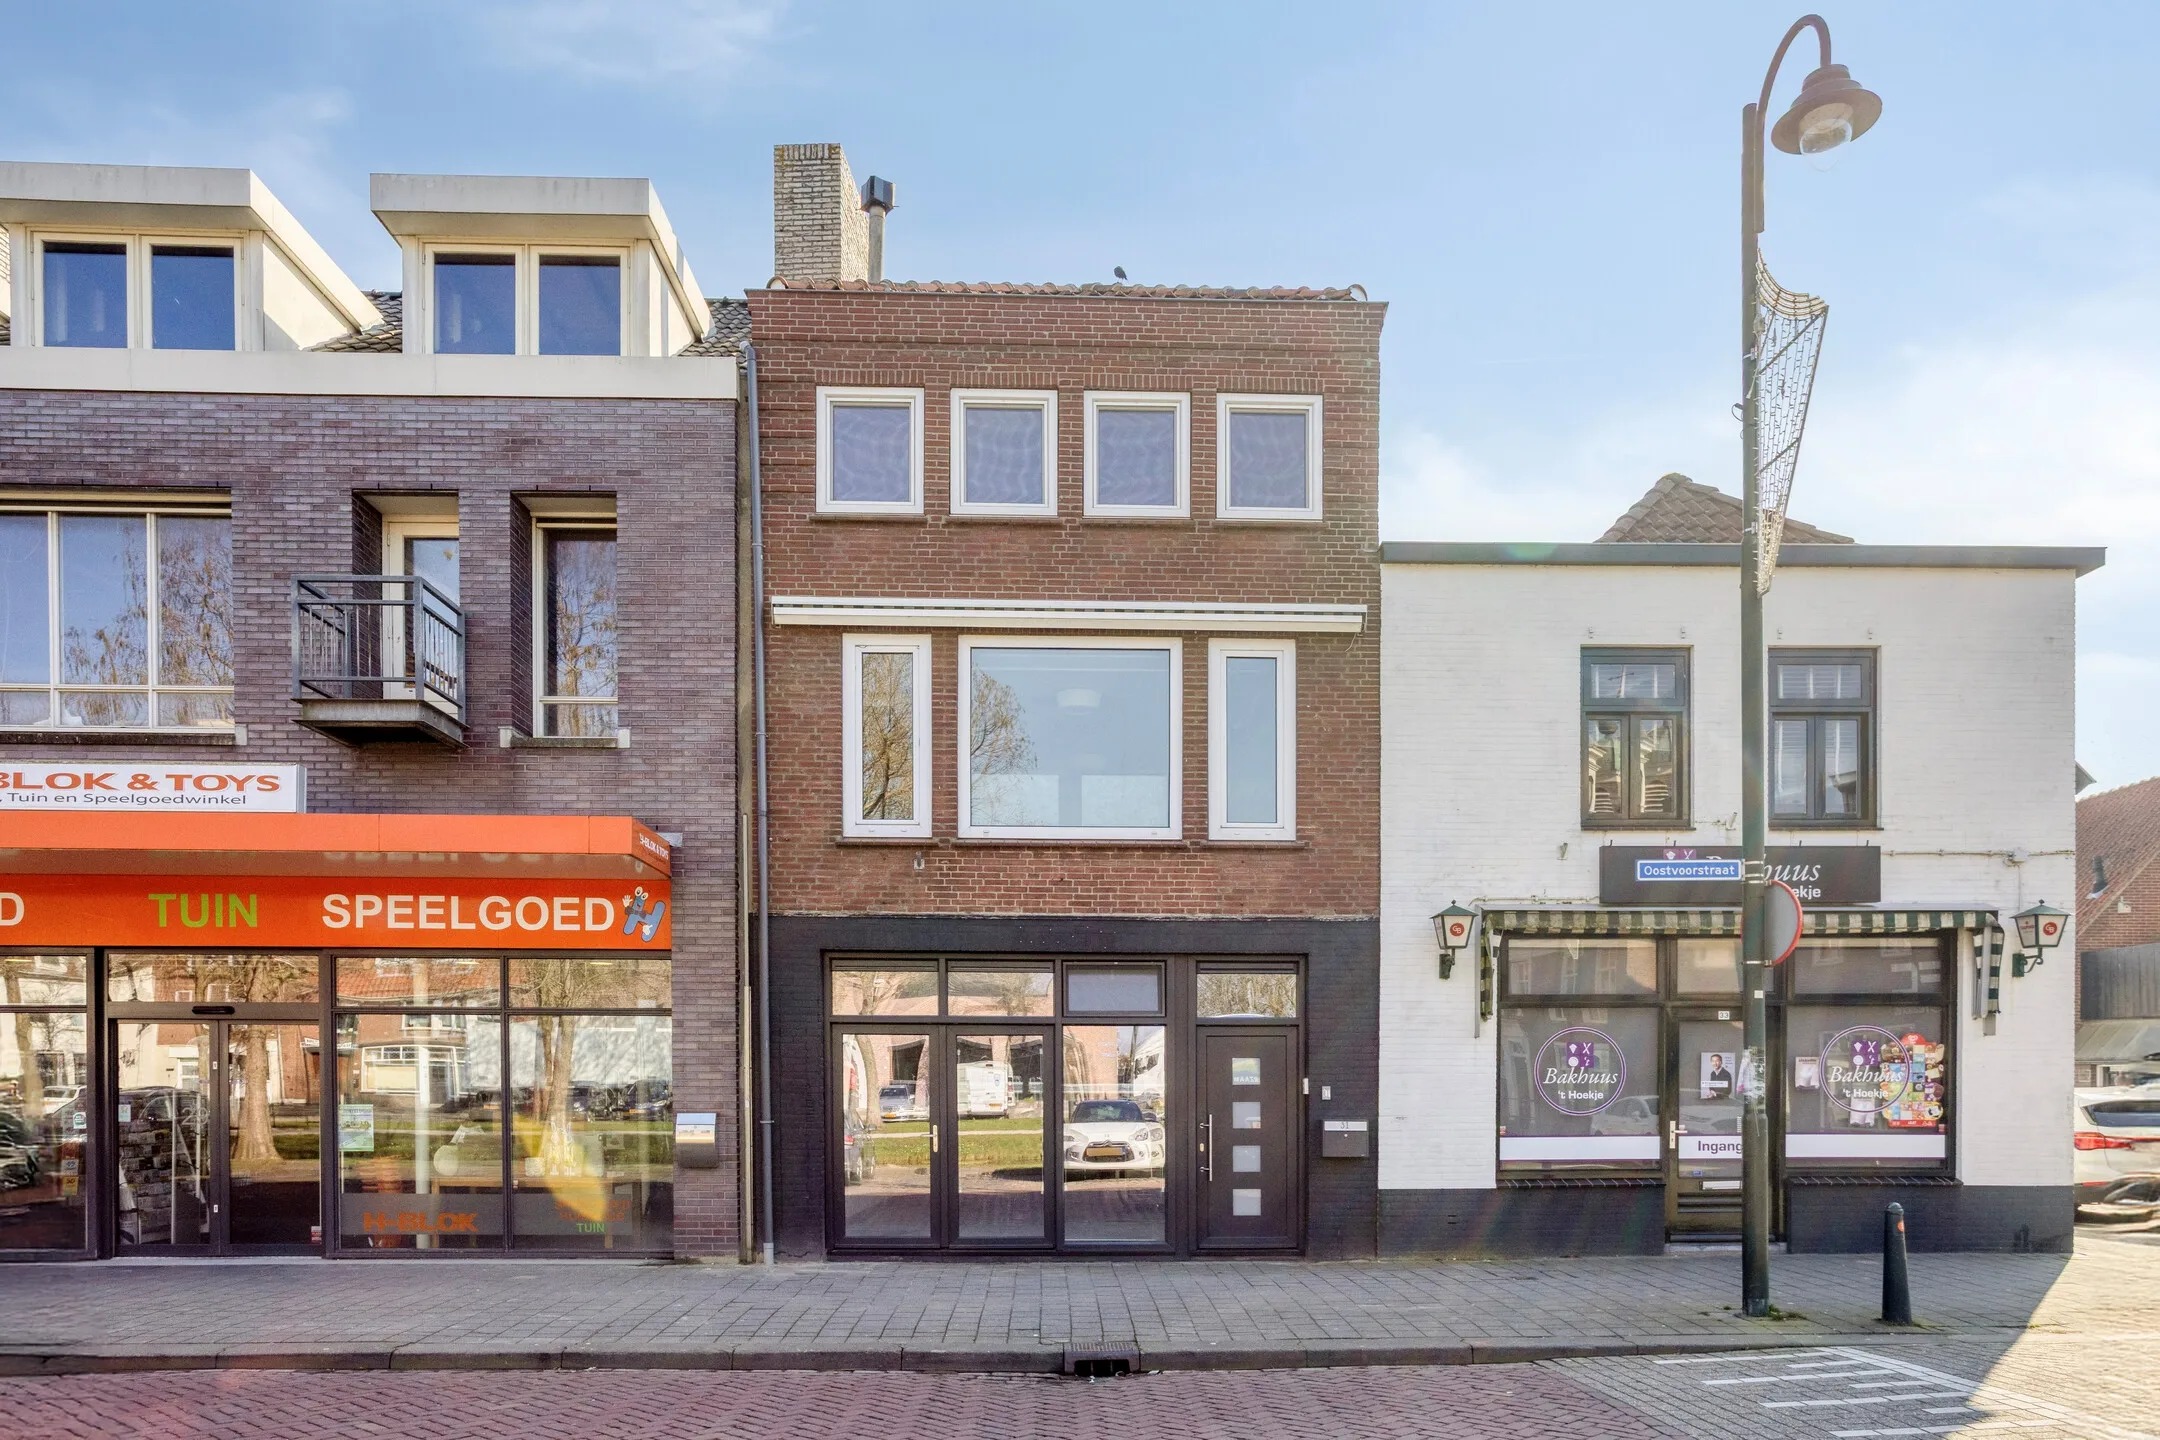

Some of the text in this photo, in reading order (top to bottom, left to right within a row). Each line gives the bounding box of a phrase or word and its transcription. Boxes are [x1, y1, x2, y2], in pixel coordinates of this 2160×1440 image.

[127, 773, 158, 791] &
[165, 774, 280, 792] TOYS
[7, 793, 247, 806] Tuin en Speelgoedwinkel
[1644, 866, 1735, 877] Oostvoorstraat
[148, 893, 258, 928] TUIN
[322, 893, 616, 932] SPEELGOED
[1543, 1066, 1618, 1084] Bakhuus
[1828, 1065, 1904, 1082] Bakhuus
[1558, 1090, 1604, 1100] 't Hoekje
[1842, 1088, 1888, 1099] 't Hoekje
[1697, 1140, 1742, 1155] Ingang
[363, 1211, 478, 1233] H-BLOK
[576, 1222, 605, 1233] TUIN
